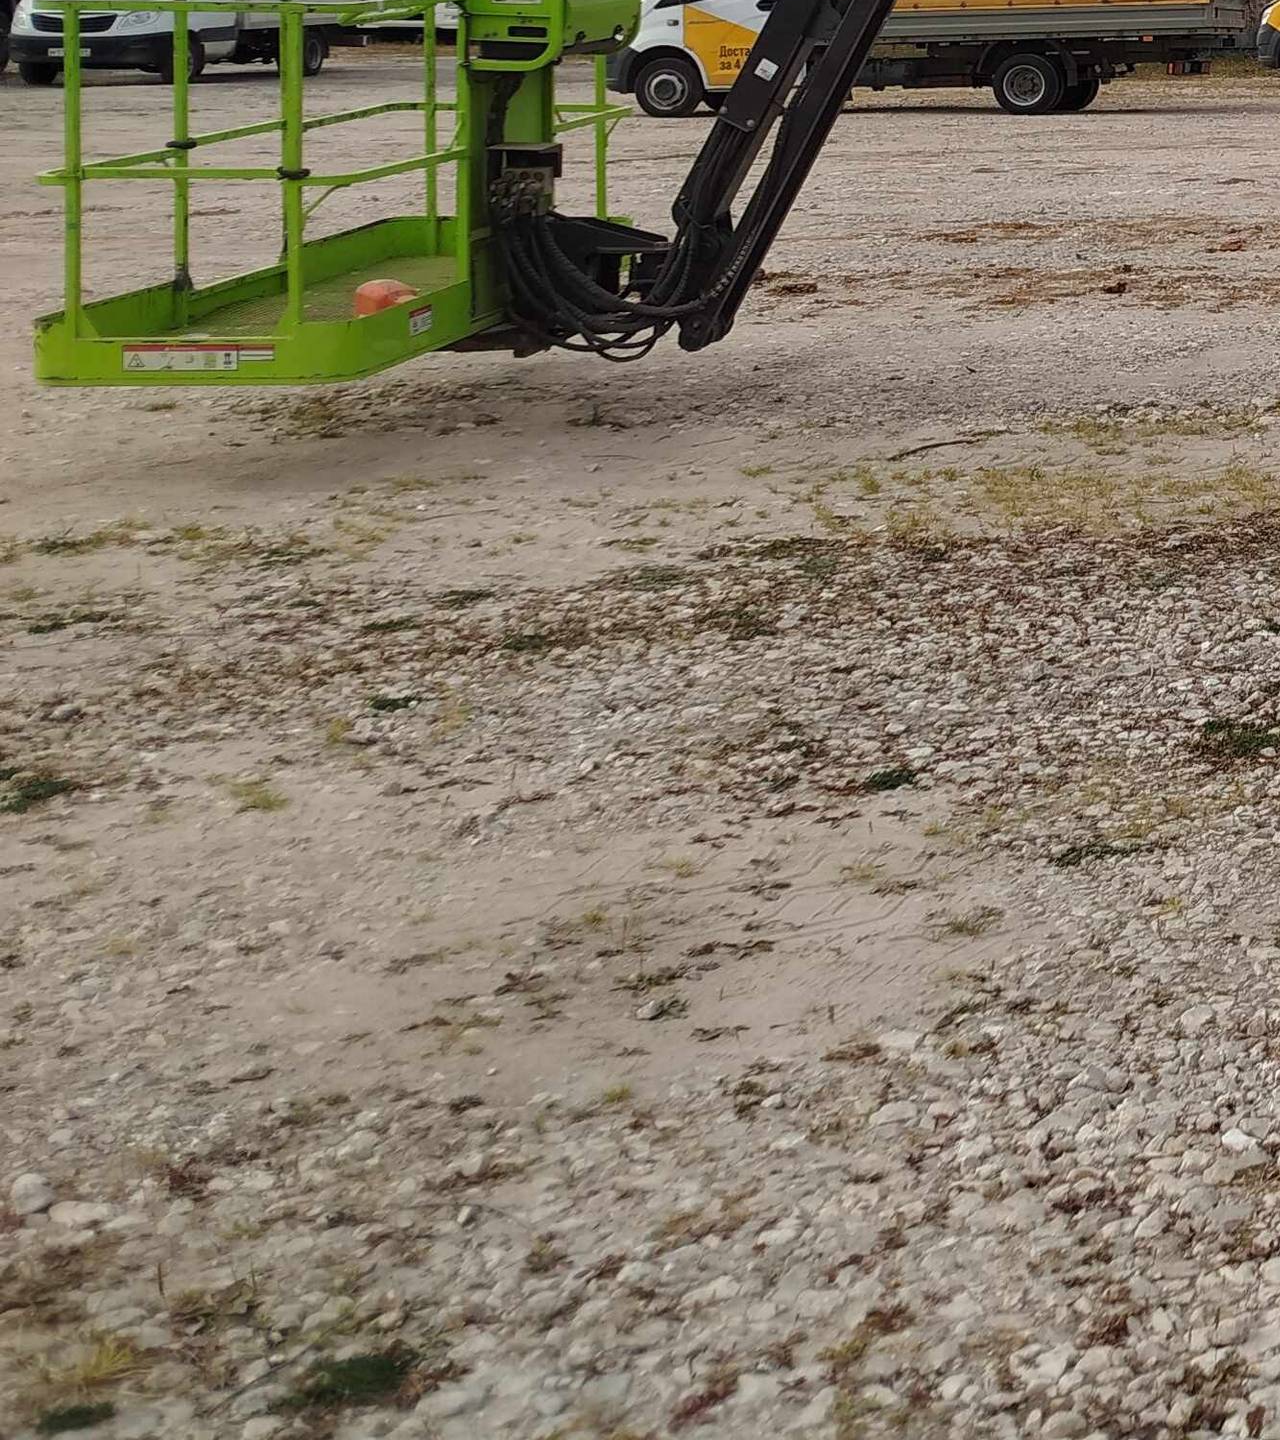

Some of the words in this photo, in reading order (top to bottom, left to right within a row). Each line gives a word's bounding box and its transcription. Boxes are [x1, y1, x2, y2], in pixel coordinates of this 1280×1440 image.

[720, 45, 751, 57] Доста
[720, 61, 732, 70] за
[734, 58, 741, 70] 4
